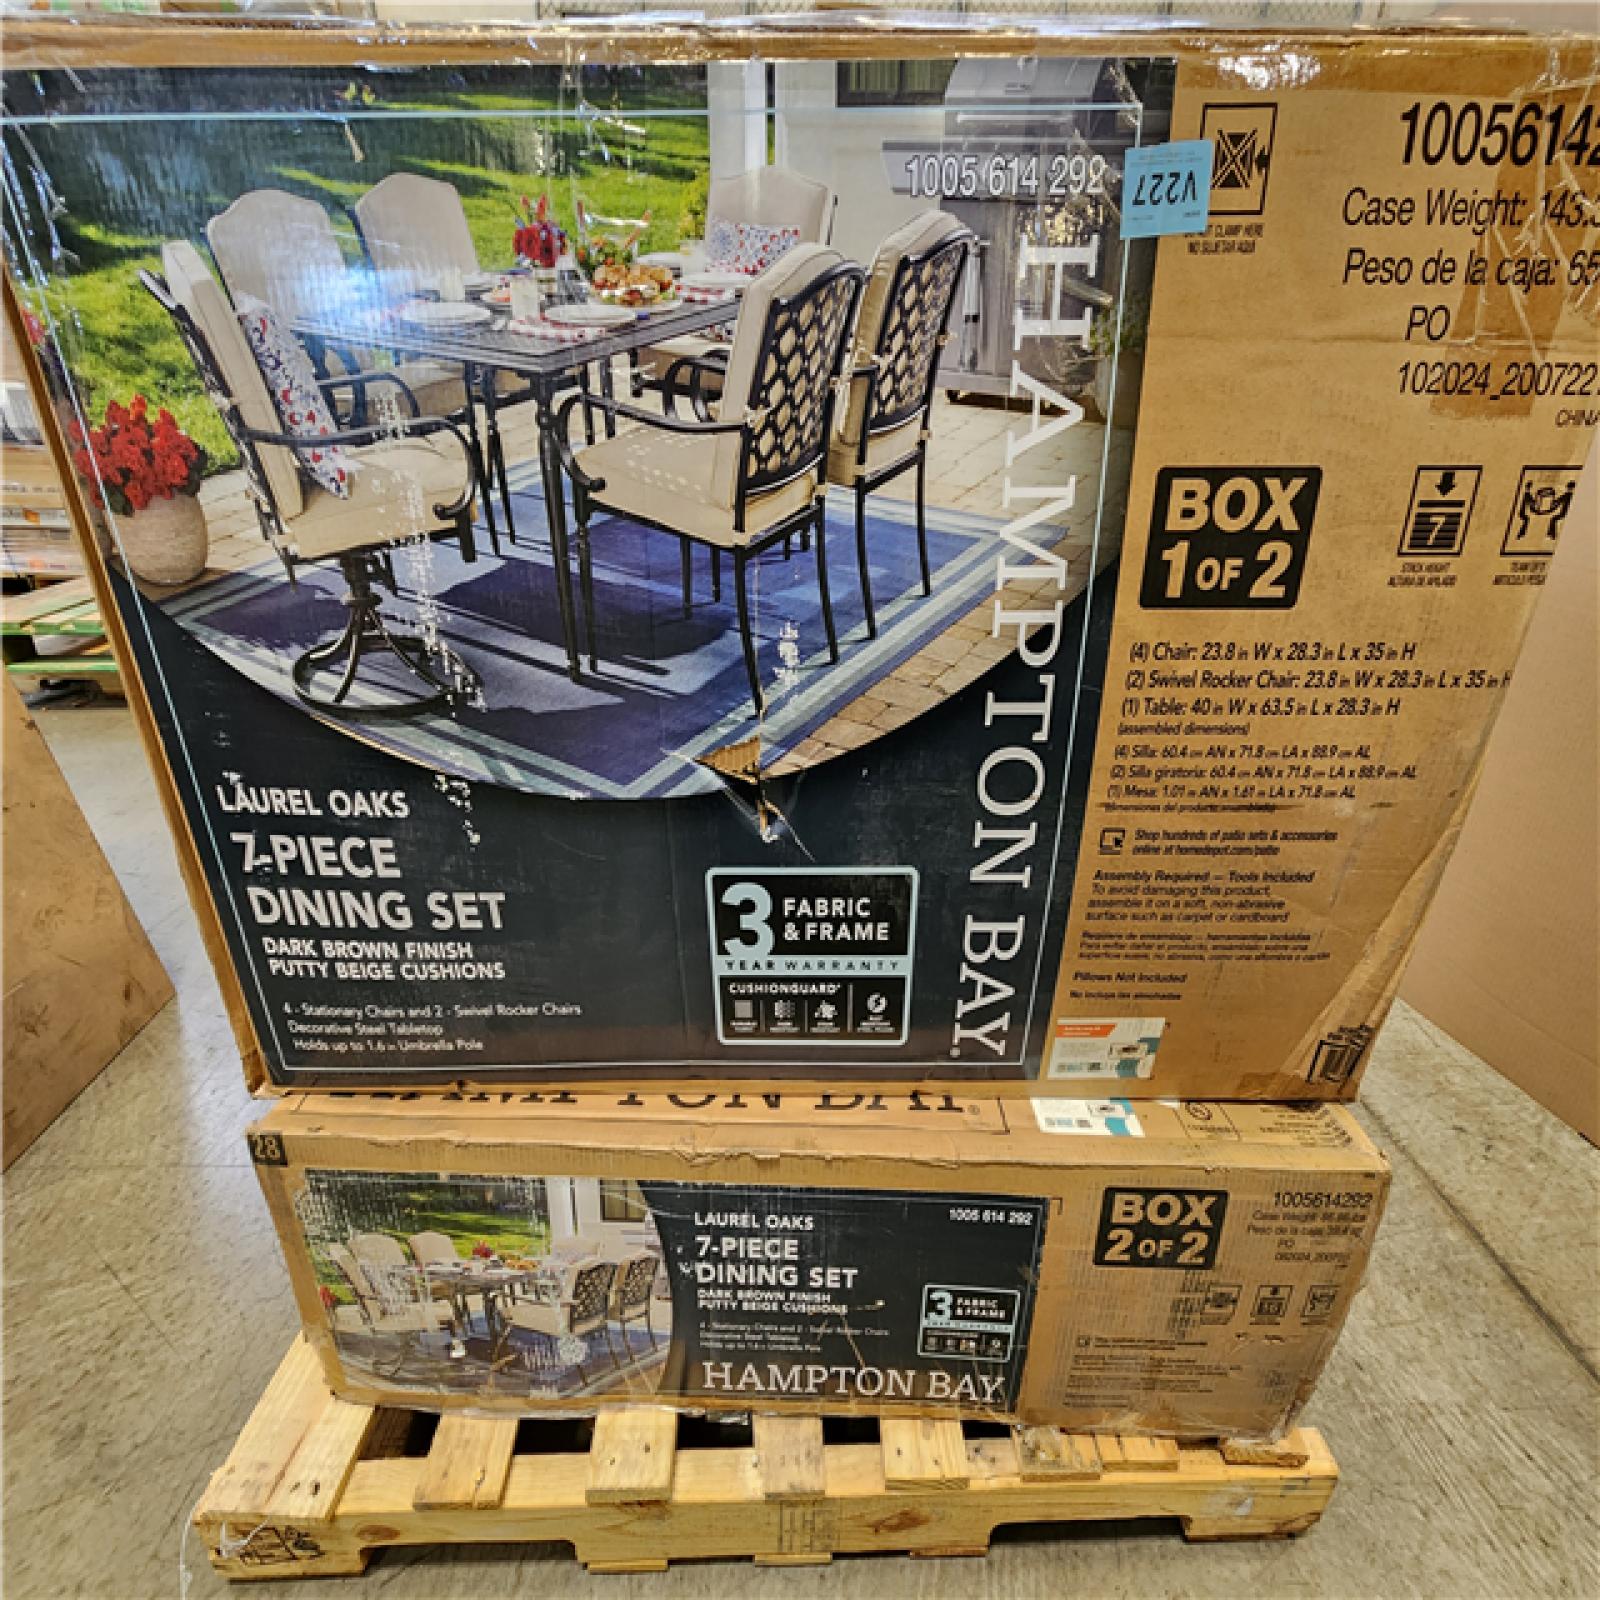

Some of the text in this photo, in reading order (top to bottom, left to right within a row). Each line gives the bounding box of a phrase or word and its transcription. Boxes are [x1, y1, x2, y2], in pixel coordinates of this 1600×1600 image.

[905, 154, 1106, 197] 1005 614 292
[1132, 169, 1198, 206] V227
[1343, 187, 1415, 226] Case
[1425, 187, 1524, 236] Weight:
[1343, 247, 1413, 285] Peso
[1421, 247, 1457, 285] de
[1465, 248, 1487, 285] la
[1495, 255, 1561, 294] caja:
[1404, 304, 1451, 341] PO
[1399, 360, 1600, 400] 102024_200722
[1164, 476, 1308, 533] BOX
[1427, 514, 1446, 546] 7
[1160, 539, 1294, 599] 1 OF 2
[954, 232, 1099, 1057] HAMPTON BAY
[1130, 642, 1150, 662] (4)
[1153, 642, 1198, 661] Chair:
[1202, 642, 1236, 661] 23.8
[1254, 642, 1272, 661] W
[1273, 647, 1284, 661] x
[1287, 642, 1322, 661] 28.3
[1337, 642, 1346, 661] L
[1350, 647, 1361, 661] x
[1364, 642, 1386, 661] 35
[1402, 642, 1418, 661] H
[1125, 669, 1488, 690] (2) Swivel Rocker Chair: 23.8 W x 28.3 L x 35
[1122, 697, 1401, 717] (1) Table: 40 W x 63.5 L x 28.3 H
[215, 784, 411, 819] LAUREL OAKS
[230, 831, 402, 879] 7-PIECE
[246, 886, 506, 931] DINING SET
[720, 881, 776, 956] 3
[782, 896, 871, 918] FABRIC
[261, 936, 474, 960] DARK BROWN FINISH
[782, 921, 891, 942] & FRAME
[269, 958, 506, 981] PUTTY BEIGE CUSHIONS
[784, 959, 900, 971] WARRANTY
[694, 1212, 815, 1231] LAUREL OAKS
[1111, 1191, 1219, 1227] BOX
[694, 1234, 799, 1261] 7-PIECE
[1103, 1229, 1211, 1264] 2 OF 2
[694, 1262, 859, 1289] DINING SET
[701, 1361, 1006, 1404] HAMPTON BAY
